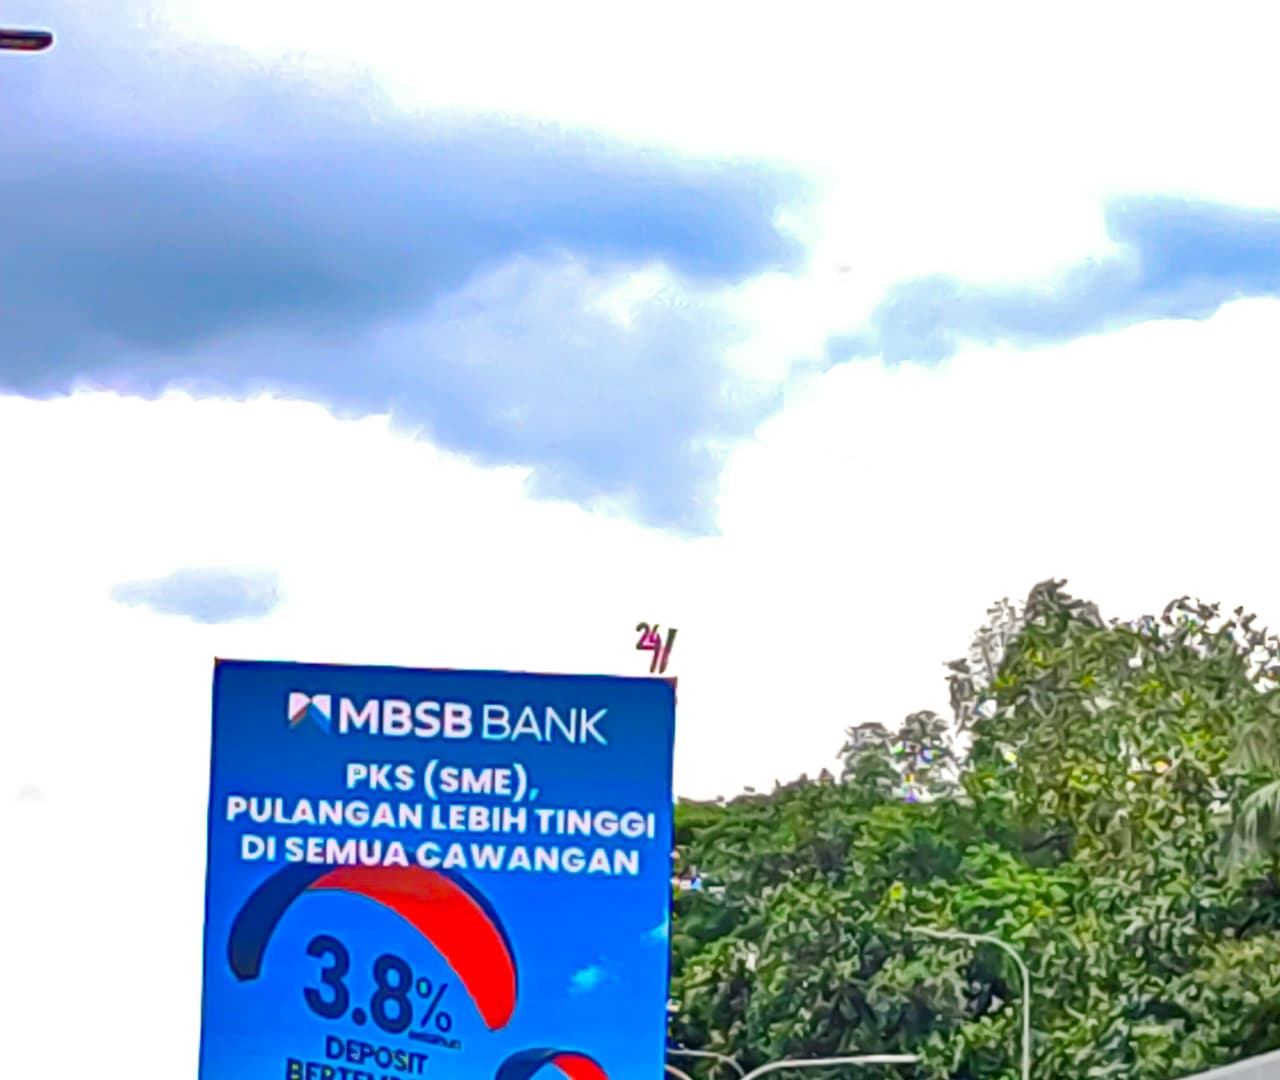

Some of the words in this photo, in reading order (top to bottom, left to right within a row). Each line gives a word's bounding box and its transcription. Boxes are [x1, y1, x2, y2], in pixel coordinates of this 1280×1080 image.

[338, 697, 473, 740] MBSB
[482, 705, 609, 745] BANK
[346, 763, 415, 791] PKS
[423, 760, 539, 800] (SME),
[226, 797, 421, 830] PULANGAN
[431, 805, 527, 834] LEBIH
[535, 809, 656, 839] TINGGI
[241, 837, 275, 861] DI
[285, 838, 409, 867] SEMUA
[416, 843, 640, 876] CAWANGAN
[303, 934, 453, 1036] 3.8%
[325, 1034, 430, 1076] DEPOSIT
